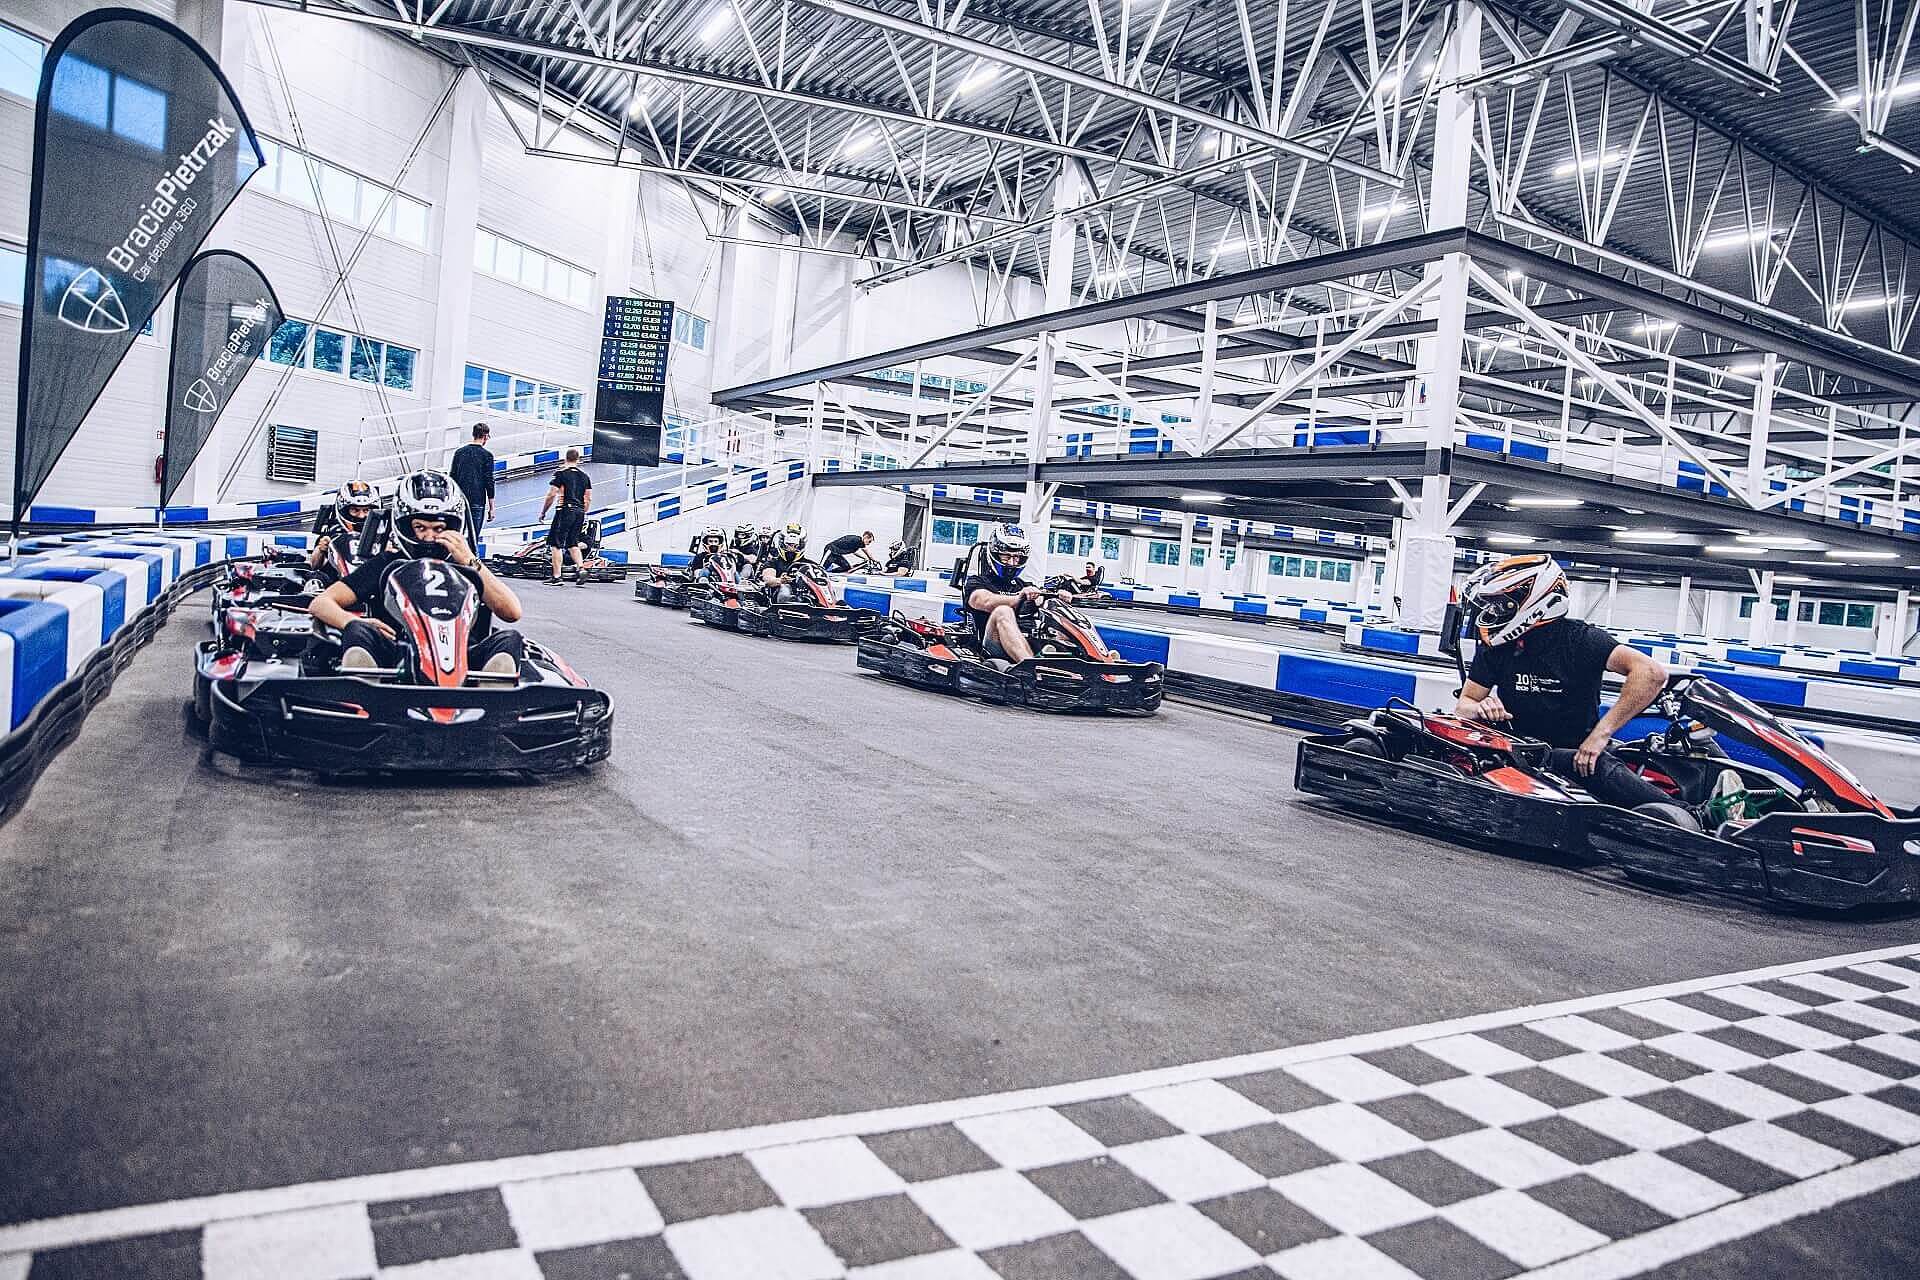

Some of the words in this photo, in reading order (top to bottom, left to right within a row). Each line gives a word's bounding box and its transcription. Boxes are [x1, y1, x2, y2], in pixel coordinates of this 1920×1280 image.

[106, 116, 235, 272] BraciaPietrzak
[179, 197, 198, 223] 360
[424, 569, 448, 597] 2
[1515, 674, 1530, 685] 10
